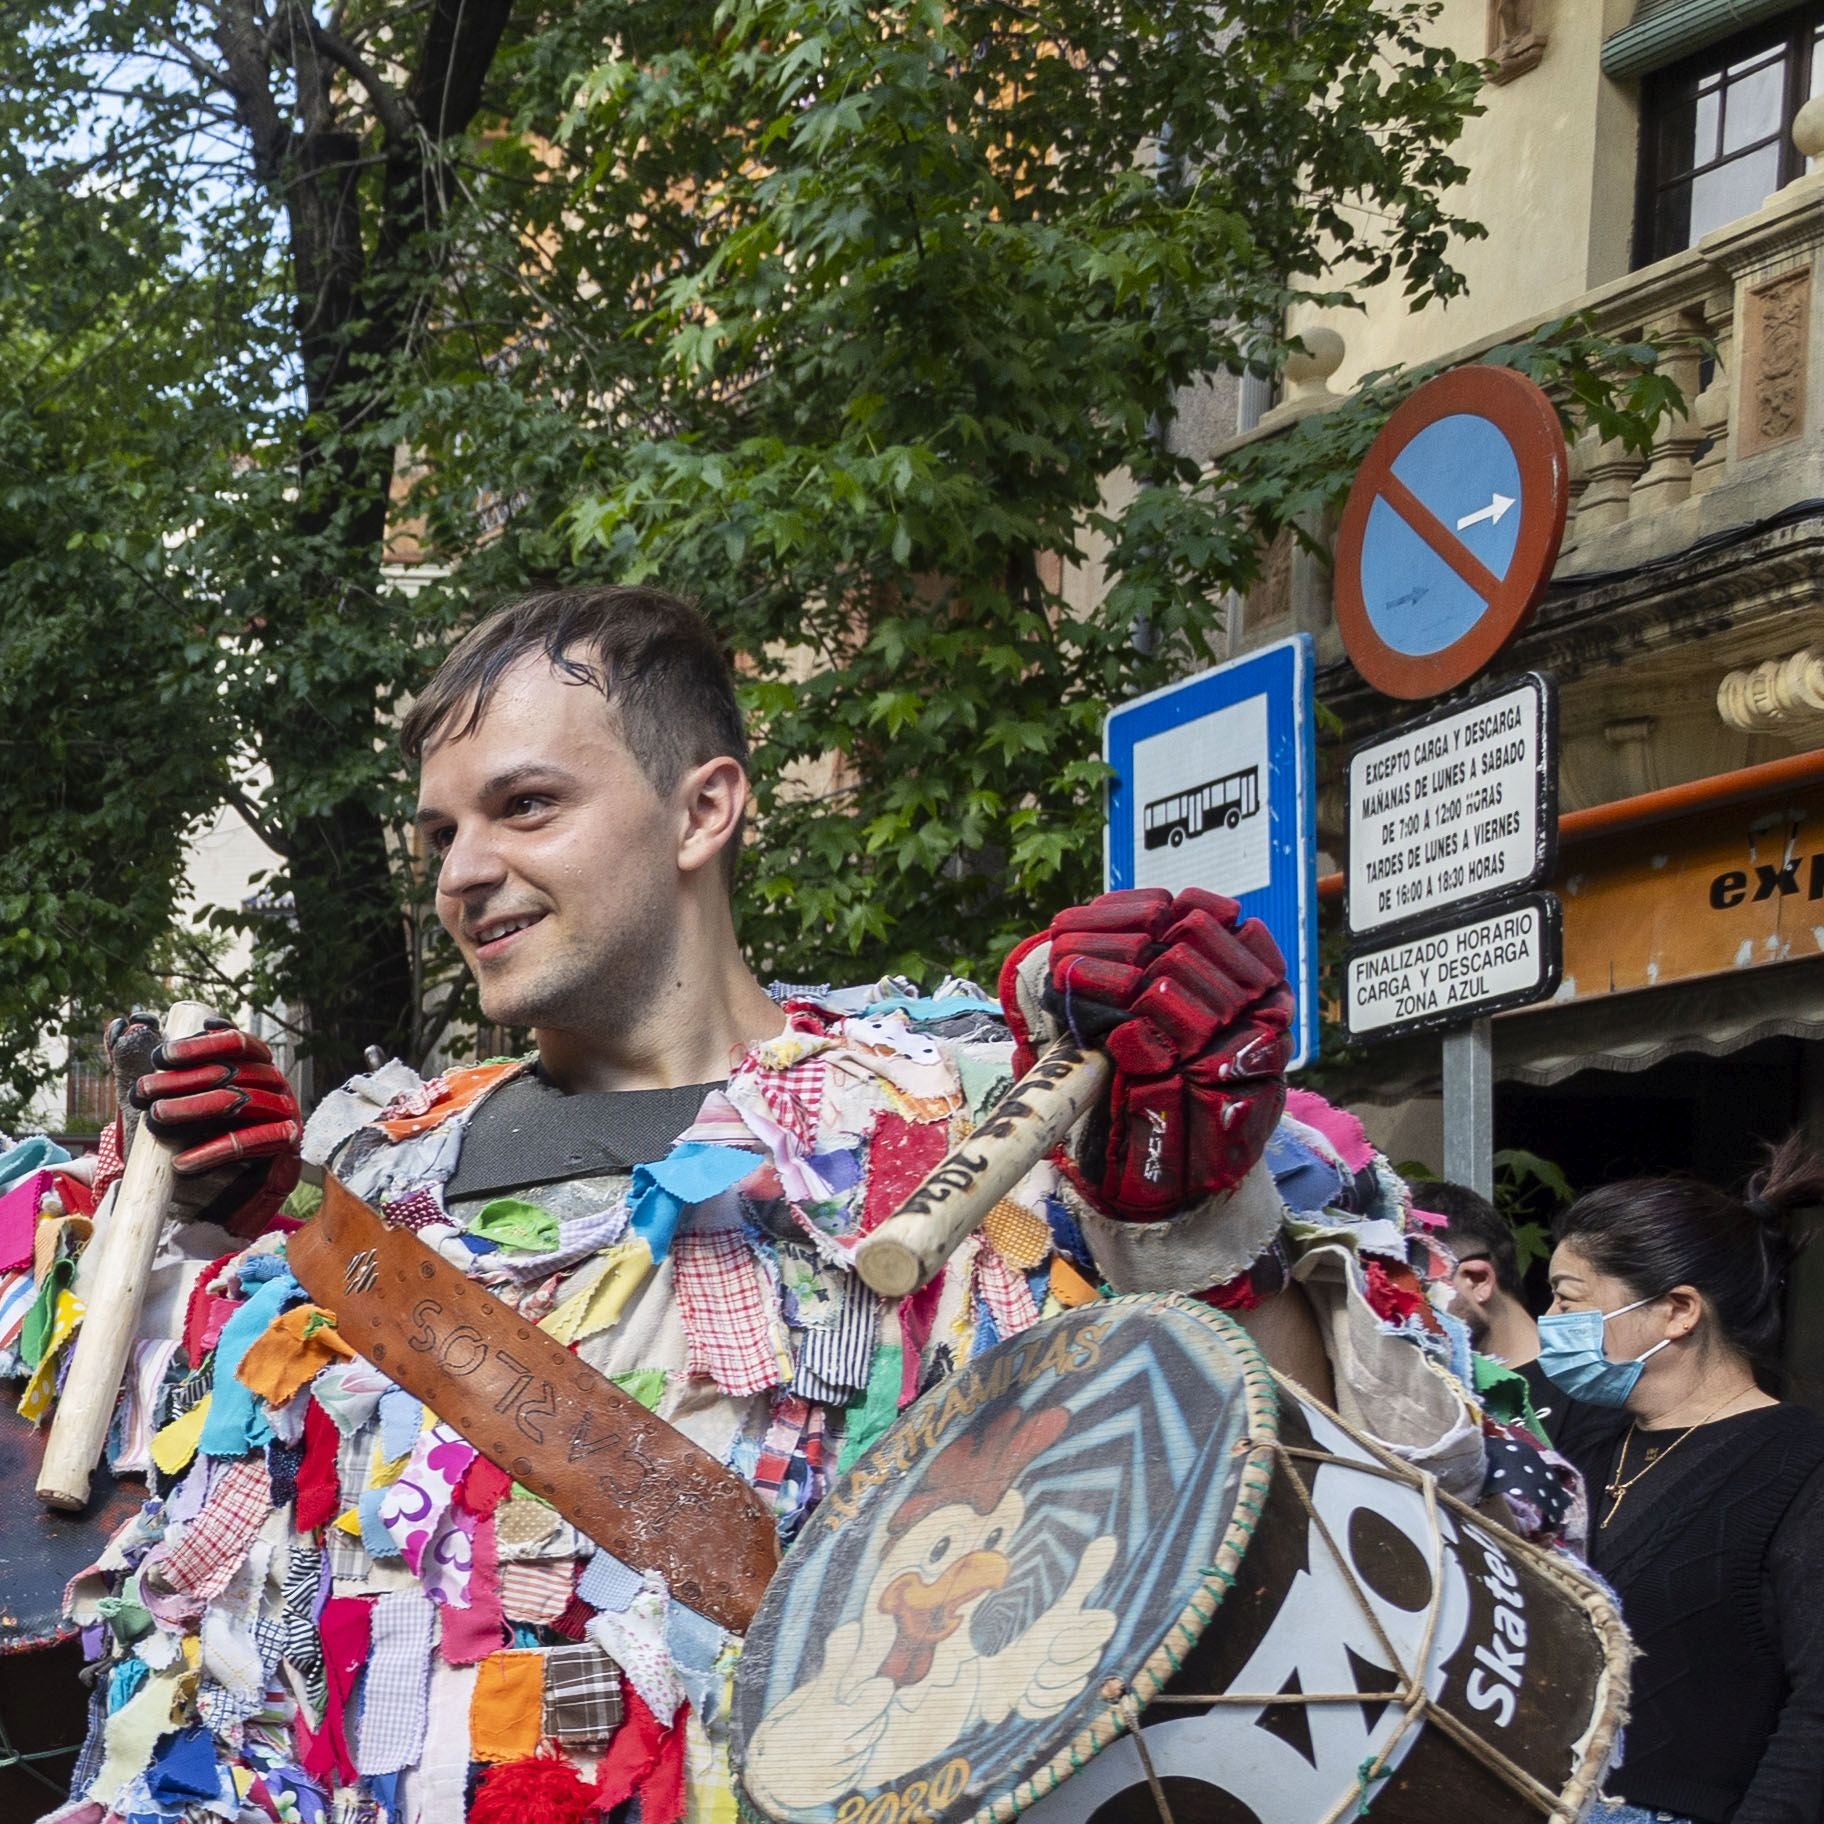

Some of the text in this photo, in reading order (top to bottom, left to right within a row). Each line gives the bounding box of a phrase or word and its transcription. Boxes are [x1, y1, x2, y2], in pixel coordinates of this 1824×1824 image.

[1362, 739, 1525, 820] MAÑANAS DE LUNES A SABADO
[1366, 706, 1522, 785] EXCEPTO CARGA Y DESCARGA
[1366, 811, 1520, 884] TARDES DE LUNES A VIERNES
[1382, 782, 1502, 845] DE 7:00 A 12:00 HORAS
[1378, 851, 1505, 912] DE 16:00 A 18:30 HORAS
[1356, 914, 1532, 983] FINALIZADO HORARIO
[1356, 939, 1529, 1006] CARGA Y DESCARGA
[1395, 975, 1490, 1018] ZONA AZUL
